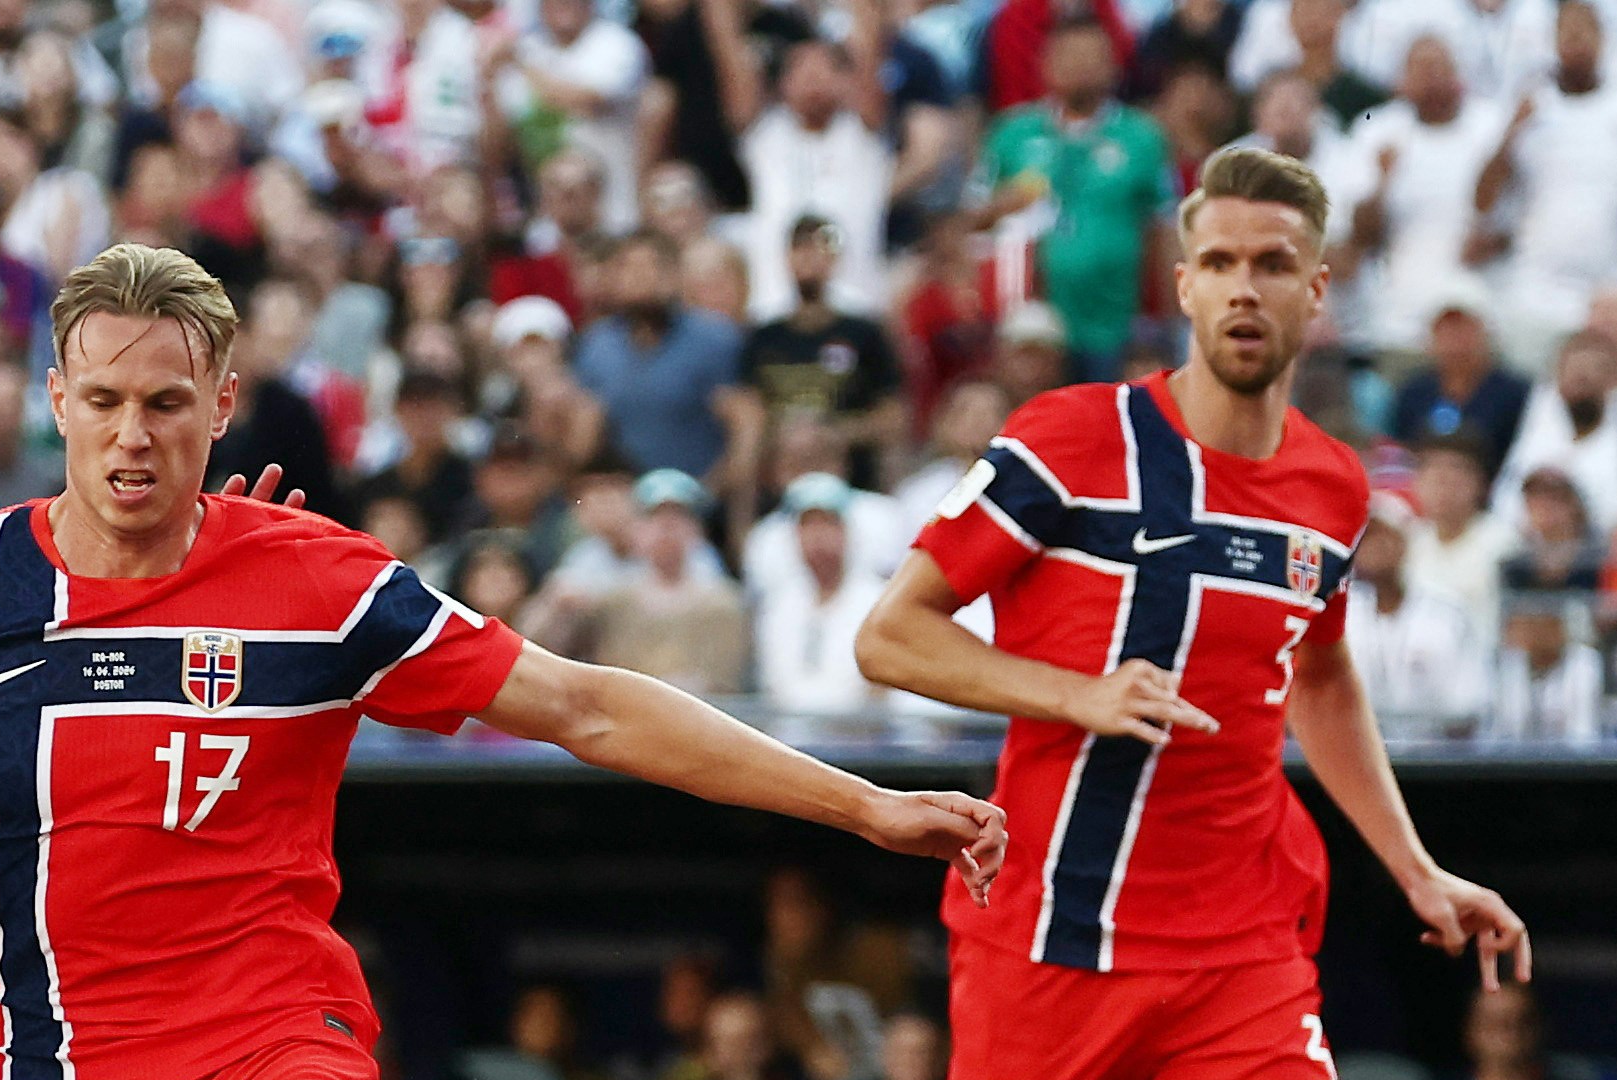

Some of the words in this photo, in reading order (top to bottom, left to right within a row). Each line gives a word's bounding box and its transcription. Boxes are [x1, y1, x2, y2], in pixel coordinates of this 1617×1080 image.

[83, 665, 135, 677] 16.06.2026
[94, 679, 124, 690] BOSTON
[1264, 614, 1310, 704] 3
[155, 731, 250, 832] 17
